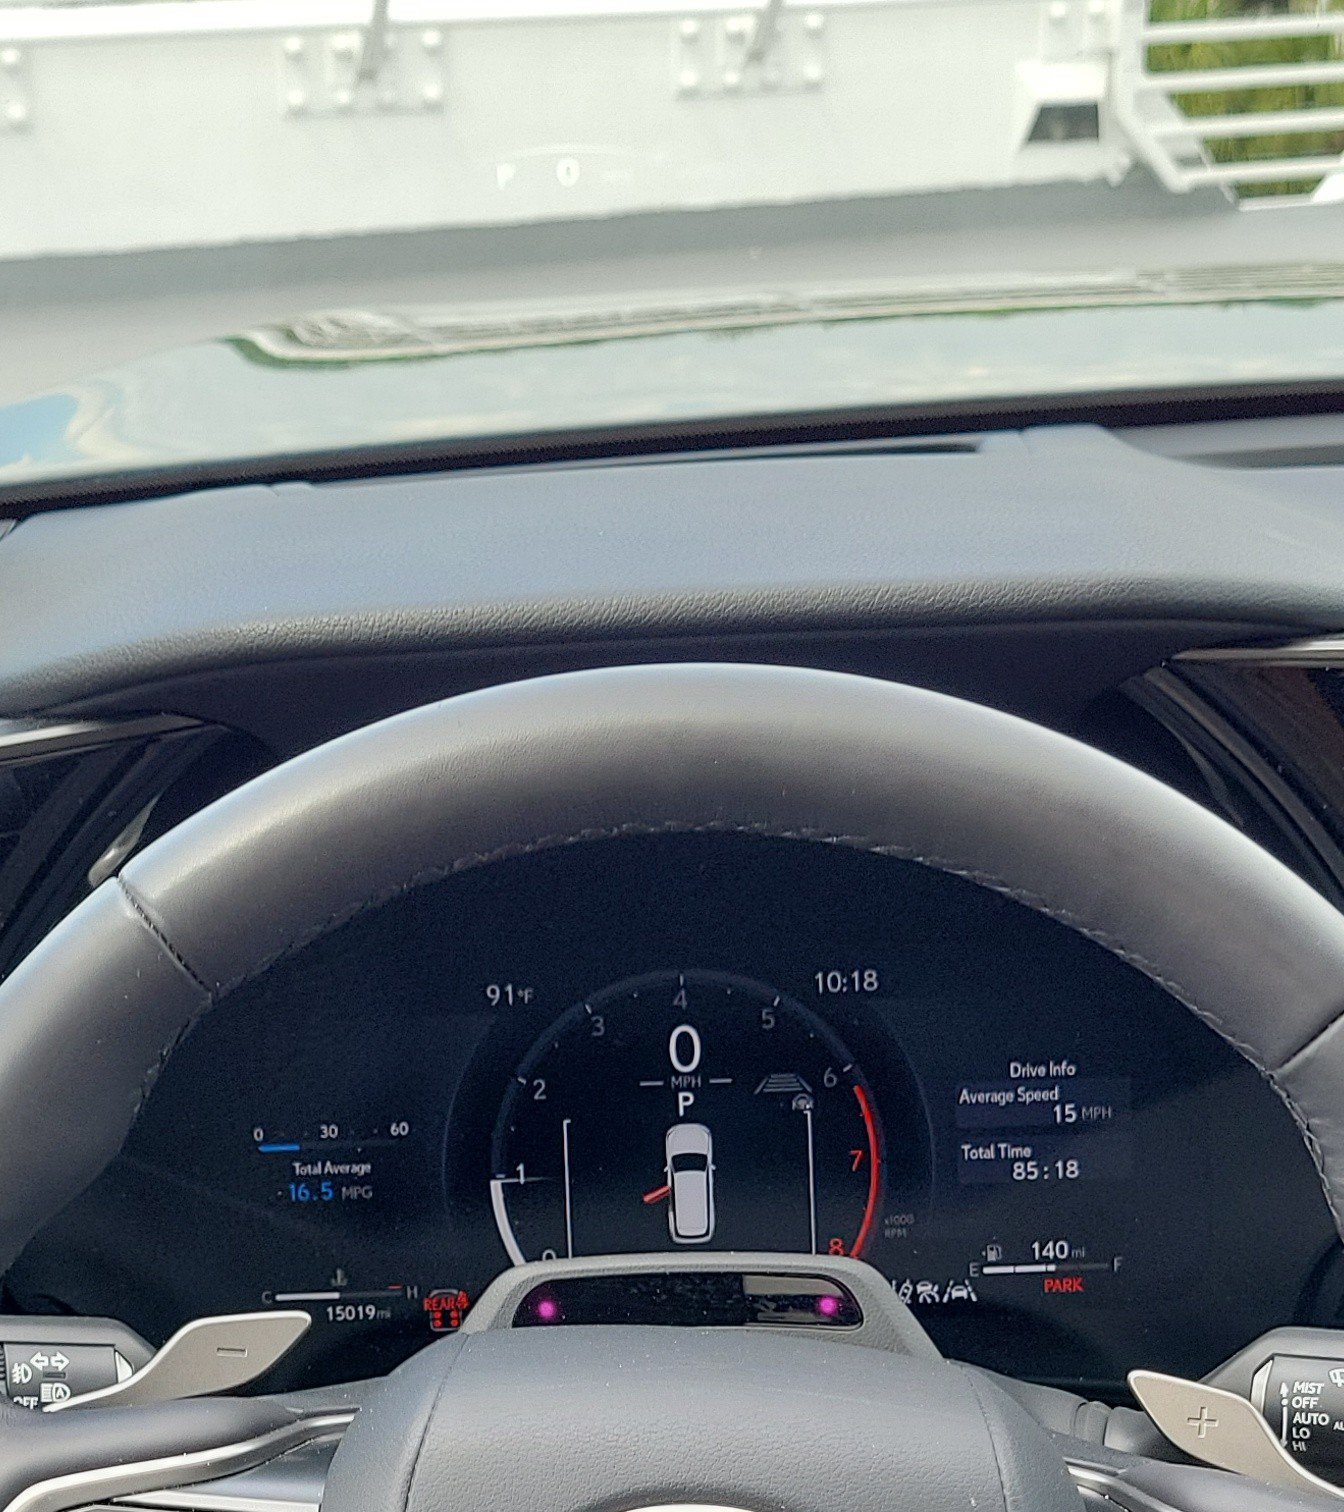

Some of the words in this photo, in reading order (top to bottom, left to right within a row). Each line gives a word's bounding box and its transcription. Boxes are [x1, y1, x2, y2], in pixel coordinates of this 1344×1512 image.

[814, 969, 879, 994] 10:18
[673, 988, 687, 1008] 4
[591, 1016, 605, 1036] 3
[762, 1010, 775, 1029] 5
[668, 1024, 702, 1073] 0
[823, 1067, 838, 1088] 6
[1009, 1062, 1046, 1078] Drive
[1049, 1061, 1076, 1077] Info
[533, 1080, 547, 1099] 2
[671, 1074, 702, 1089] MPH
[678, 1092, 694, 1116] P
[958, 1087, 1014, 1105] Average
[1017, 1086, 1059, 1105] Speed
[1053, 1104, 1077, 1123] 15
[1081, 1106, 1112, 1121] MPH
[253, 1127, 263, 1142] 0
[319, 1124, 339, 1139] 30
[389, 1121, 409, 1137] 60
[849, 1150, 862, 1171] 7
[961, 1143, 994, 1160] Total
[998, 1143, 1032, 1159] Time
[292, 1161, 321, 1176] Total
[323, 1160, 371, 1177] Average
[515, 1164, 526, 1185] 1
[288, 1181, 334, 1202] 16.5
[341, 1184, 373, 1200] MPG
[1031, 1241, 1069, 1261] 140
[969, 1263, 980, 1277] E
[1044, 1276, 1084, 1293] PARK
[1292, 1381, 1324, 1394] MIST
[1291, 1397, 1319, 1409] OFF
[1292, 1412, 1330, 1426] AUTO
[1292, 1427, 1310, 1439] LO
